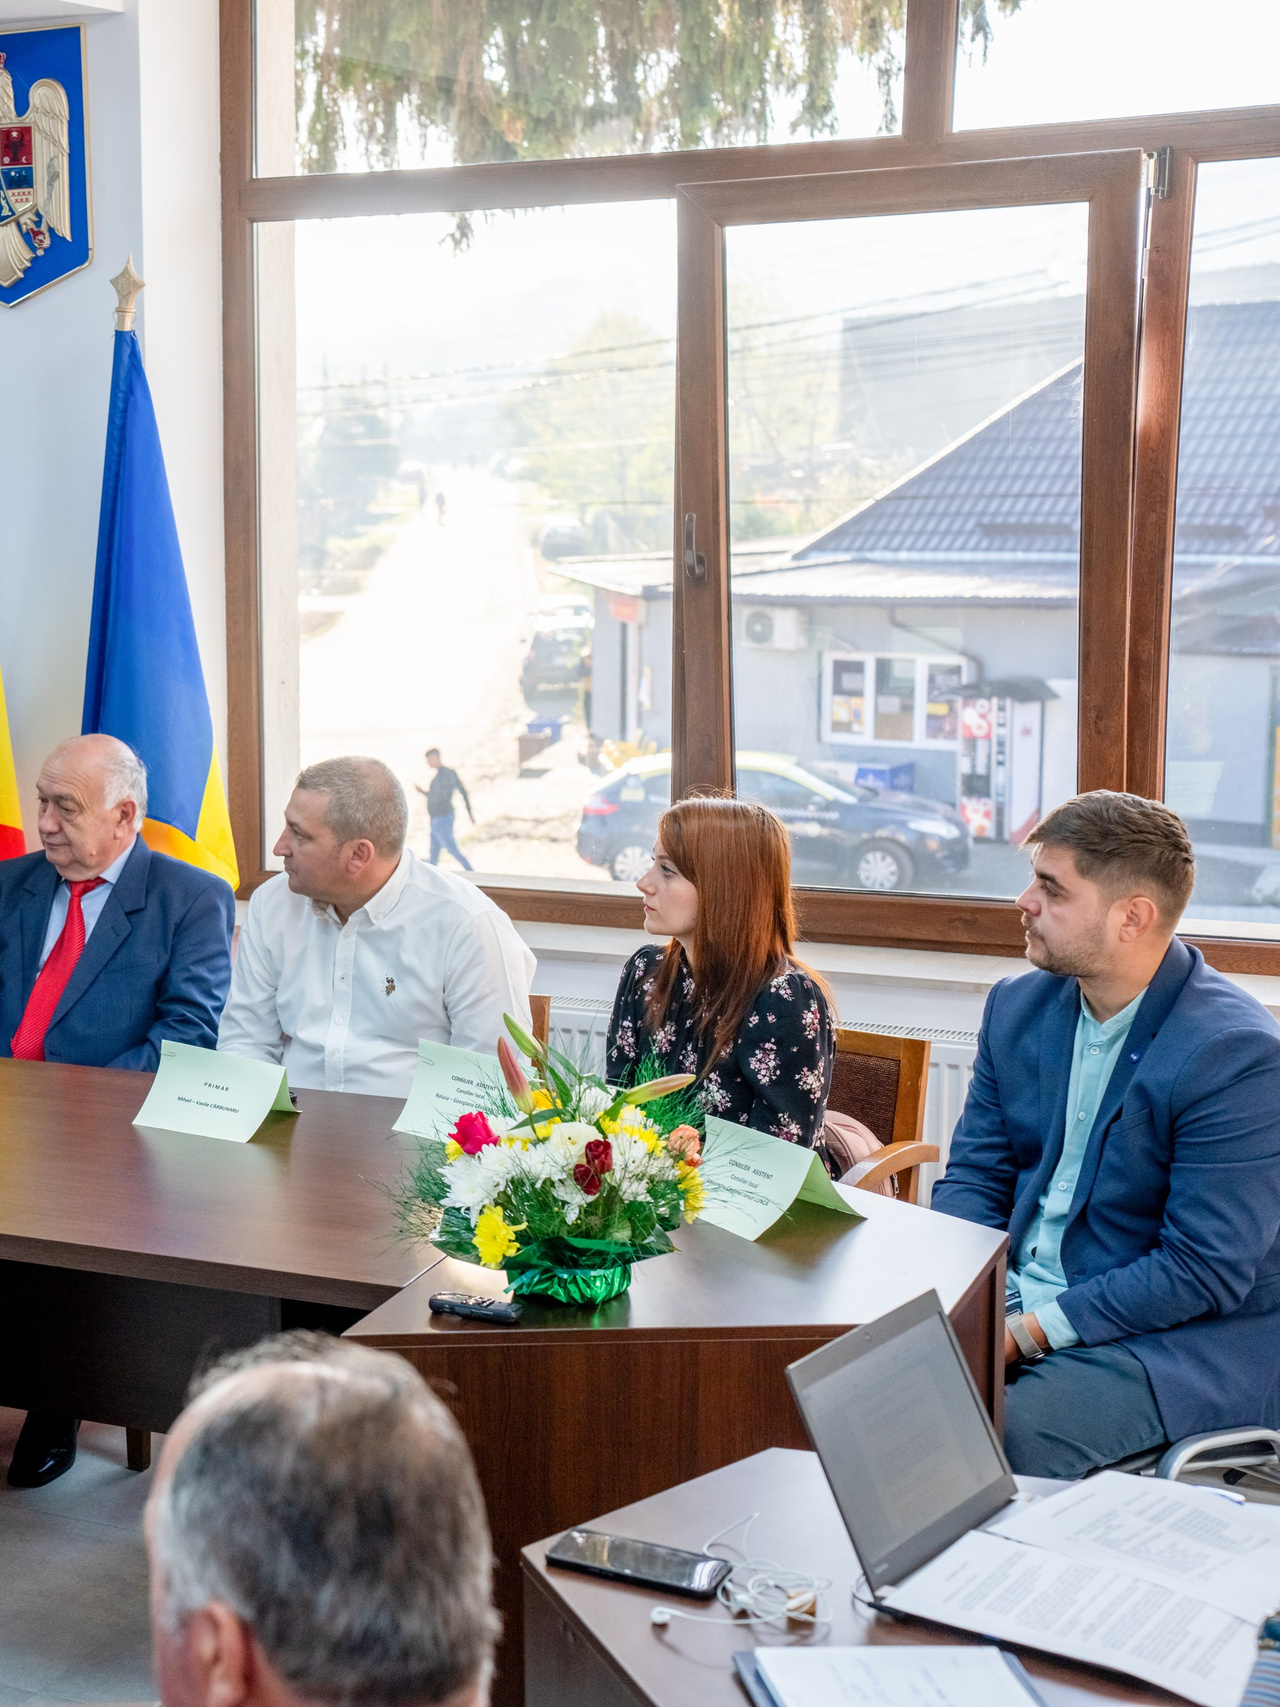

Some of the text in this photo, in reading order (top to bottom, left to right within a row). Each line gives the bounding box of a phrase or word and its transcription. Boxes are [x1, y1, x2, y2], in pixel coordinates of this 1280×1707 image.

[451, 1075, 474, 1085] CONSILIER
[203, 1081, 230, 1092] PRIMAR
[456, 1087, 475, 1096] Consilier
[196, 1100, 210, 1108] Vasile
[452, 1097, 474, 1107] Georgiana
[728, 1158, 773, 1180] CONSILIER ASISTENT
[730, 1173, 760, 1189] Consilier local
